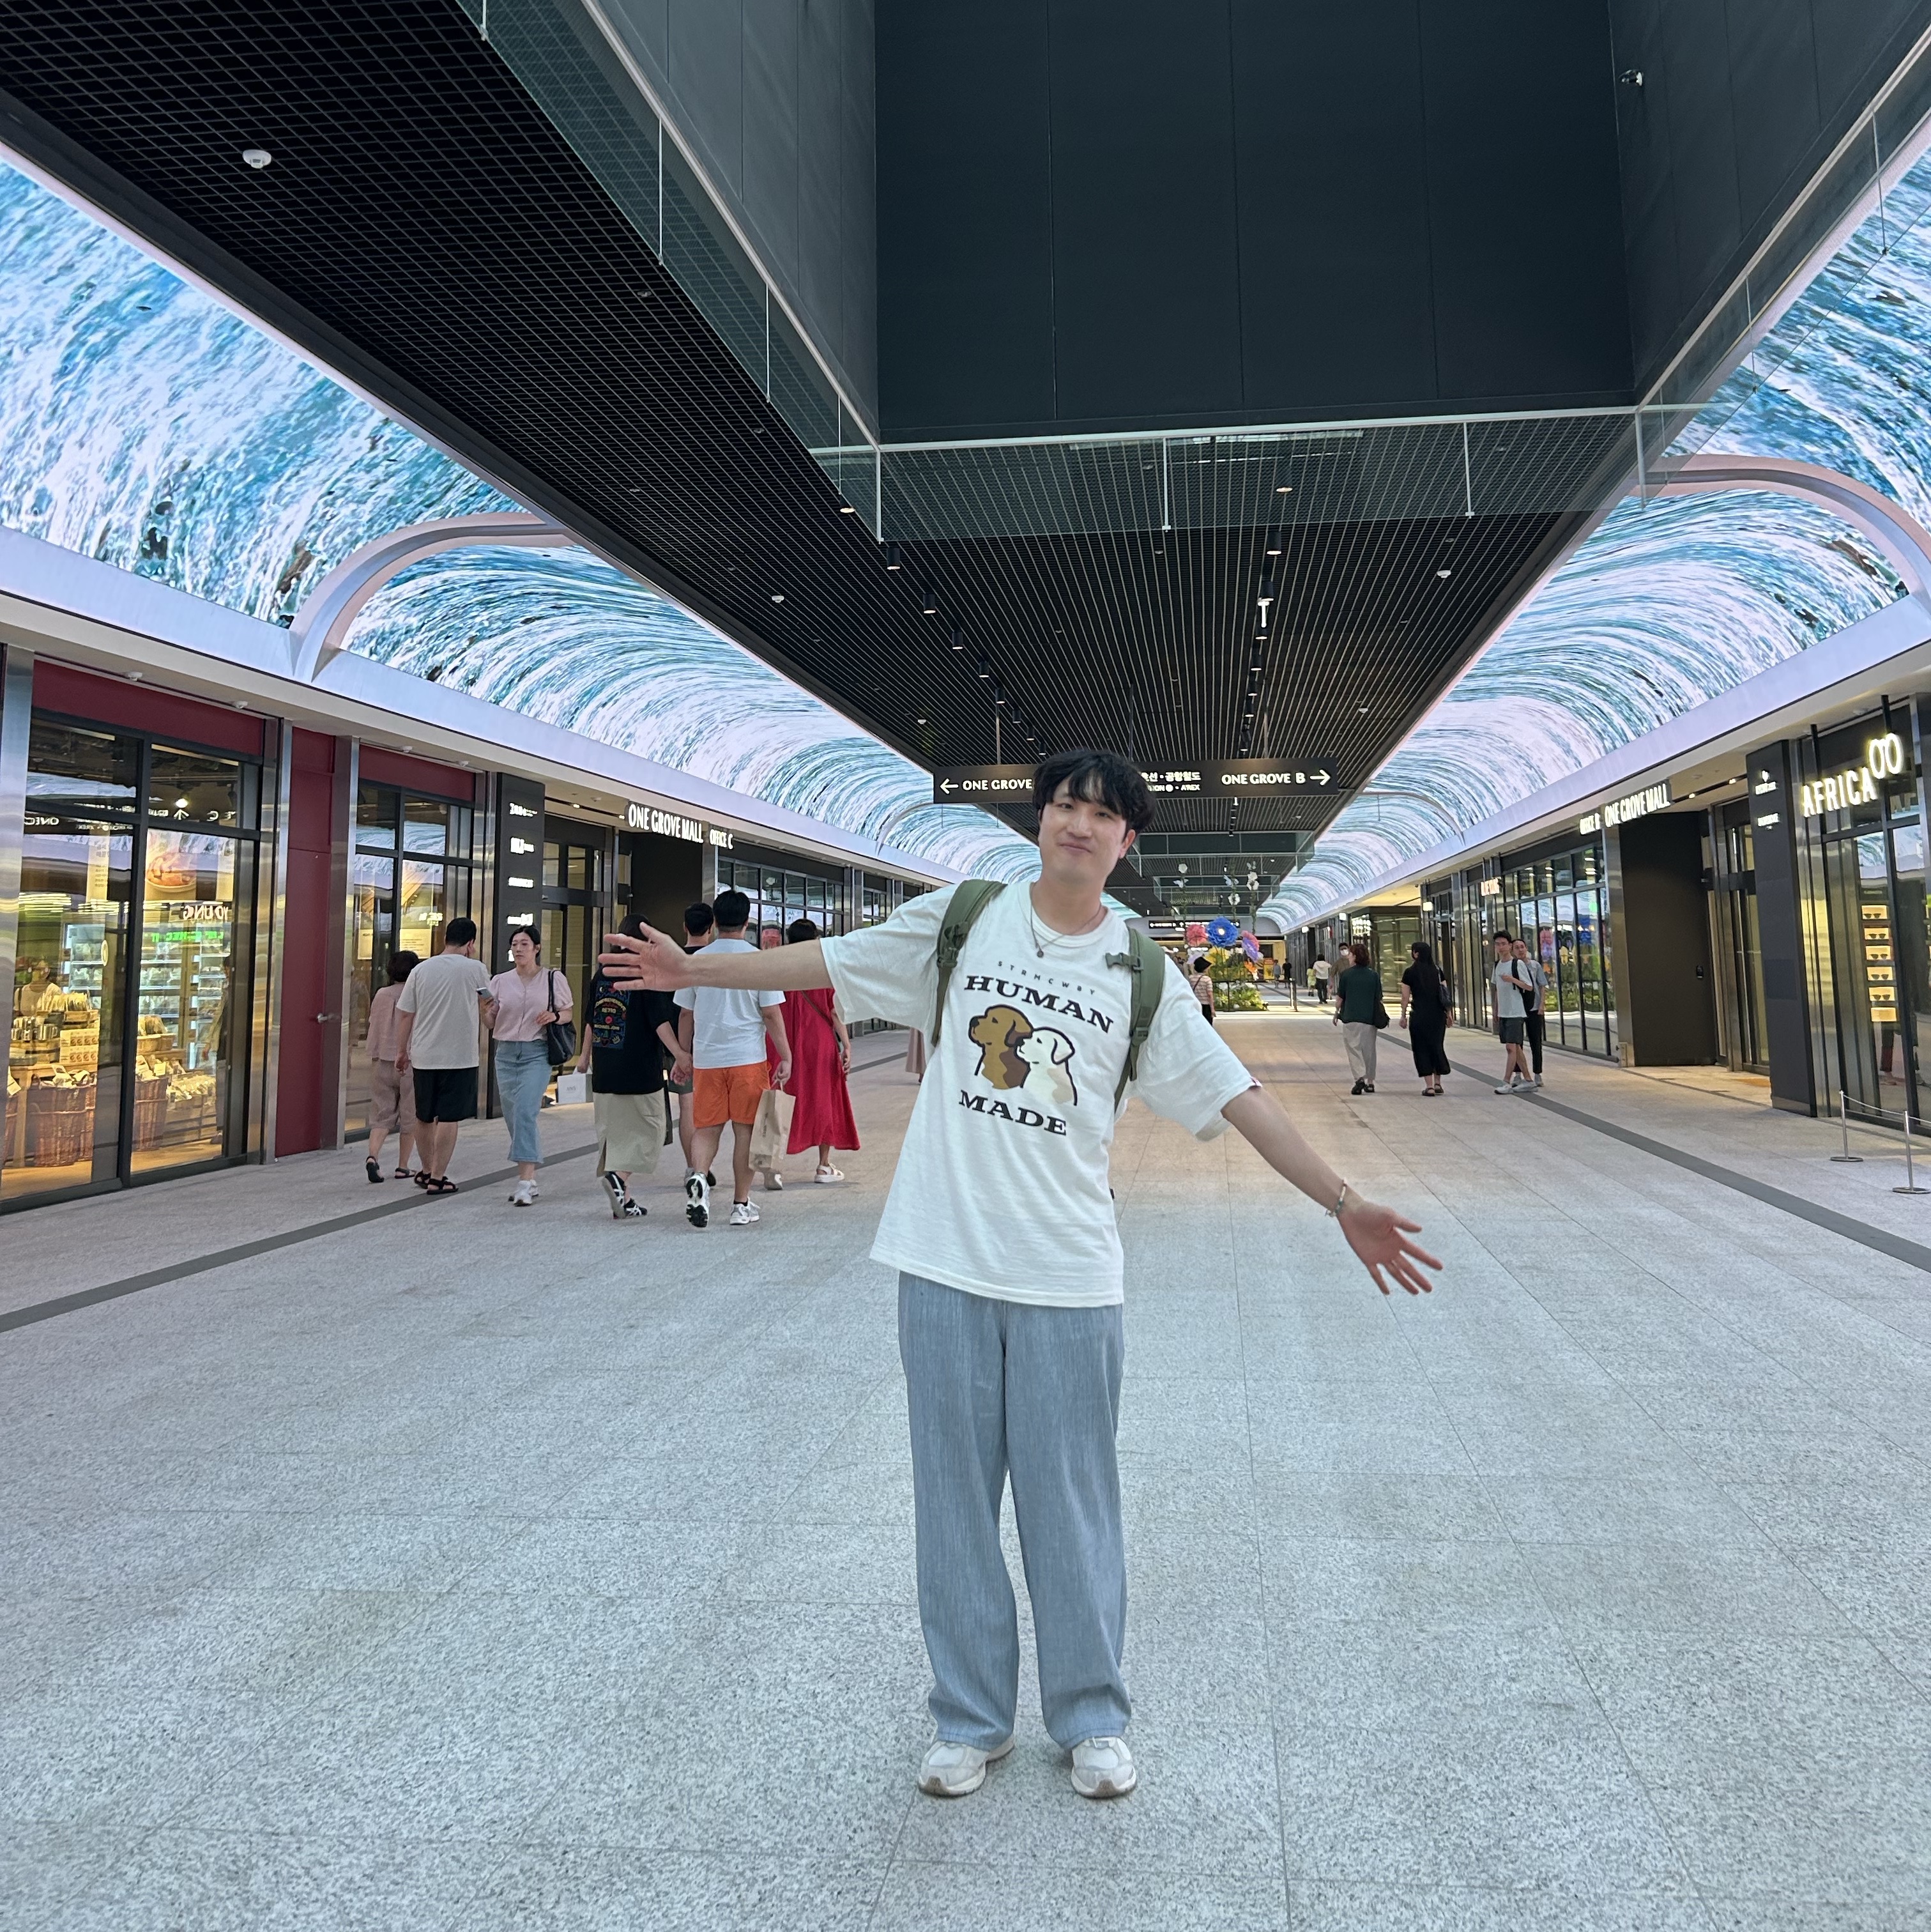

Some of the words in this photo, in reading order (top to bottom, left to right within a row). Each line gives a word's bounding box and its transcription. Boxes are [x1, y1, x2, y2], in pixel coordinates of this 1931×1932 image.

[963, 779, 988, 790] ONE
[991, 779, 1032, 790] GROVE
[1221, 774, 1248, 785] ONE
[1249, 773, 1291, 784] GROVE
[1295, 772, 1306, 783] B
[1803, 767, 1877, 817] AFRICA
[629, 804, 650, 831] ONE
[651, 810, 681, 838] GROVE
[682, 818, 703, 843] MALL
[1605, 802, 1621, 827] ONE
[1621, 792, 1647, 822] GROVE
[1645, 783, 1670, 812] MALL
[710, 829, 727, 848] OFFICE
[728, 833, 733, 849] C
[964, 975, 1114, 1034] HUMAN
[959, 1089, 1067, 1136] MADE
